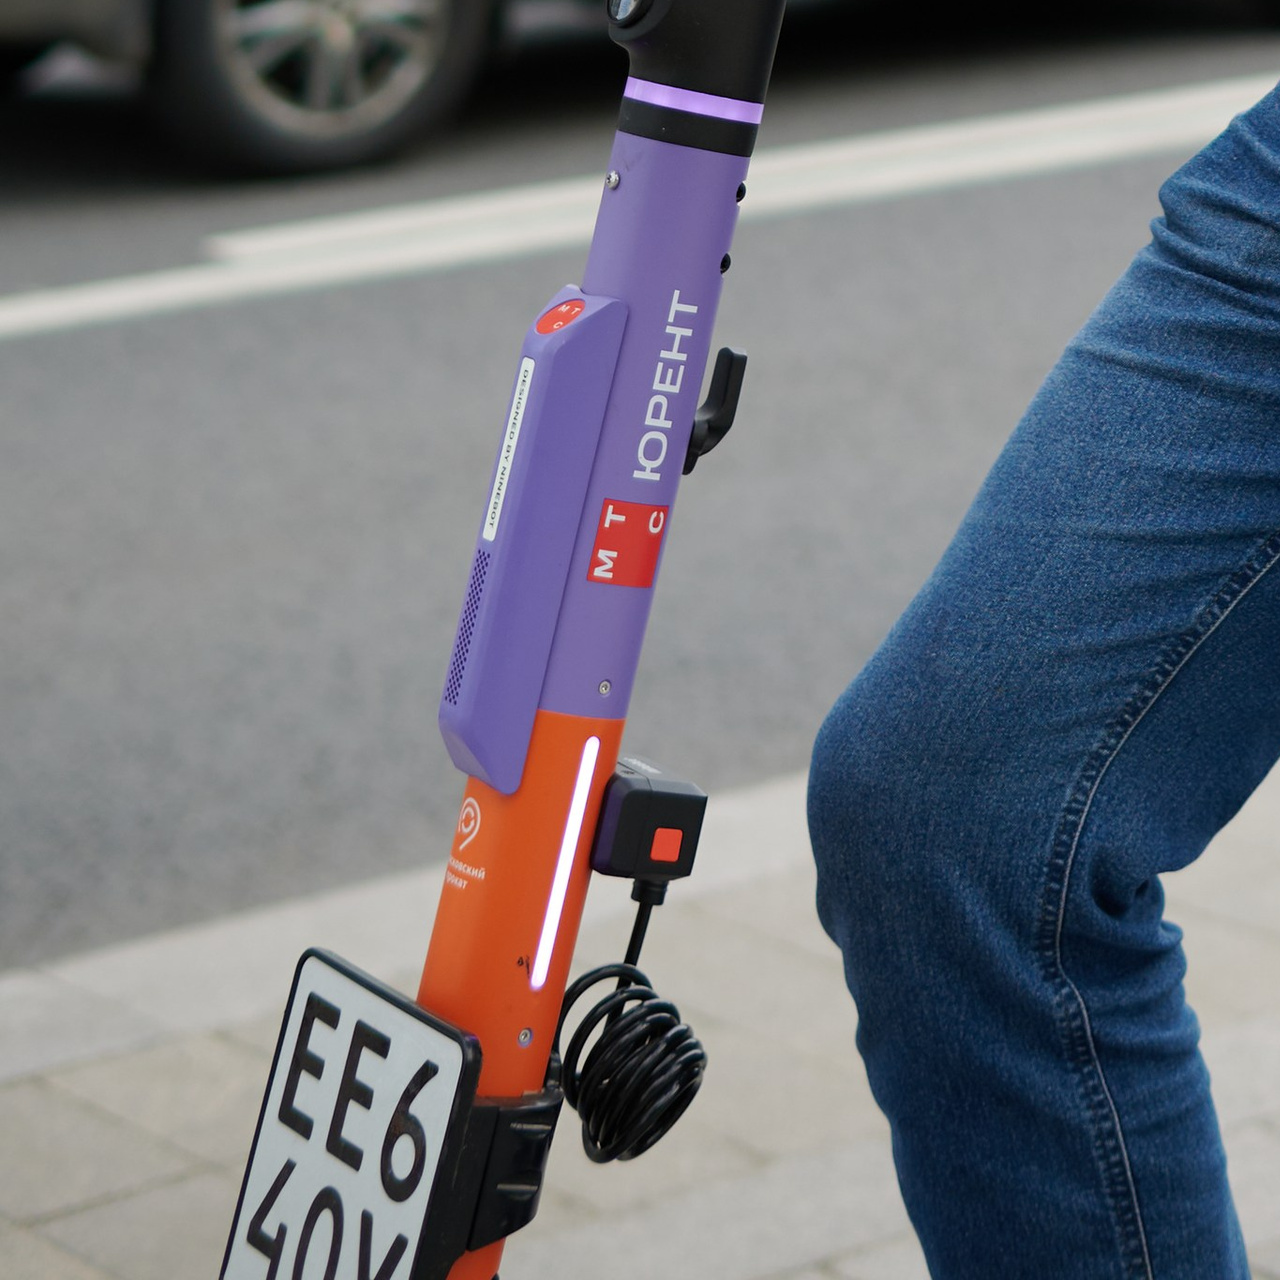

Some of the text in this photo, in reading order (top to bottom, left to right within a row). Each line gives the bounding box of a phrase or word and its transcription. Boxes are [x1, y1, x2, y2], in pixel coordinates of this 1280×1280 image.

[488, 369, 529, 529] DESIGNED BY NINEBOT
[632, 289, 698, 481] ЮРЕНТ
[278, 991, 439, 1203] ЕЕ6
